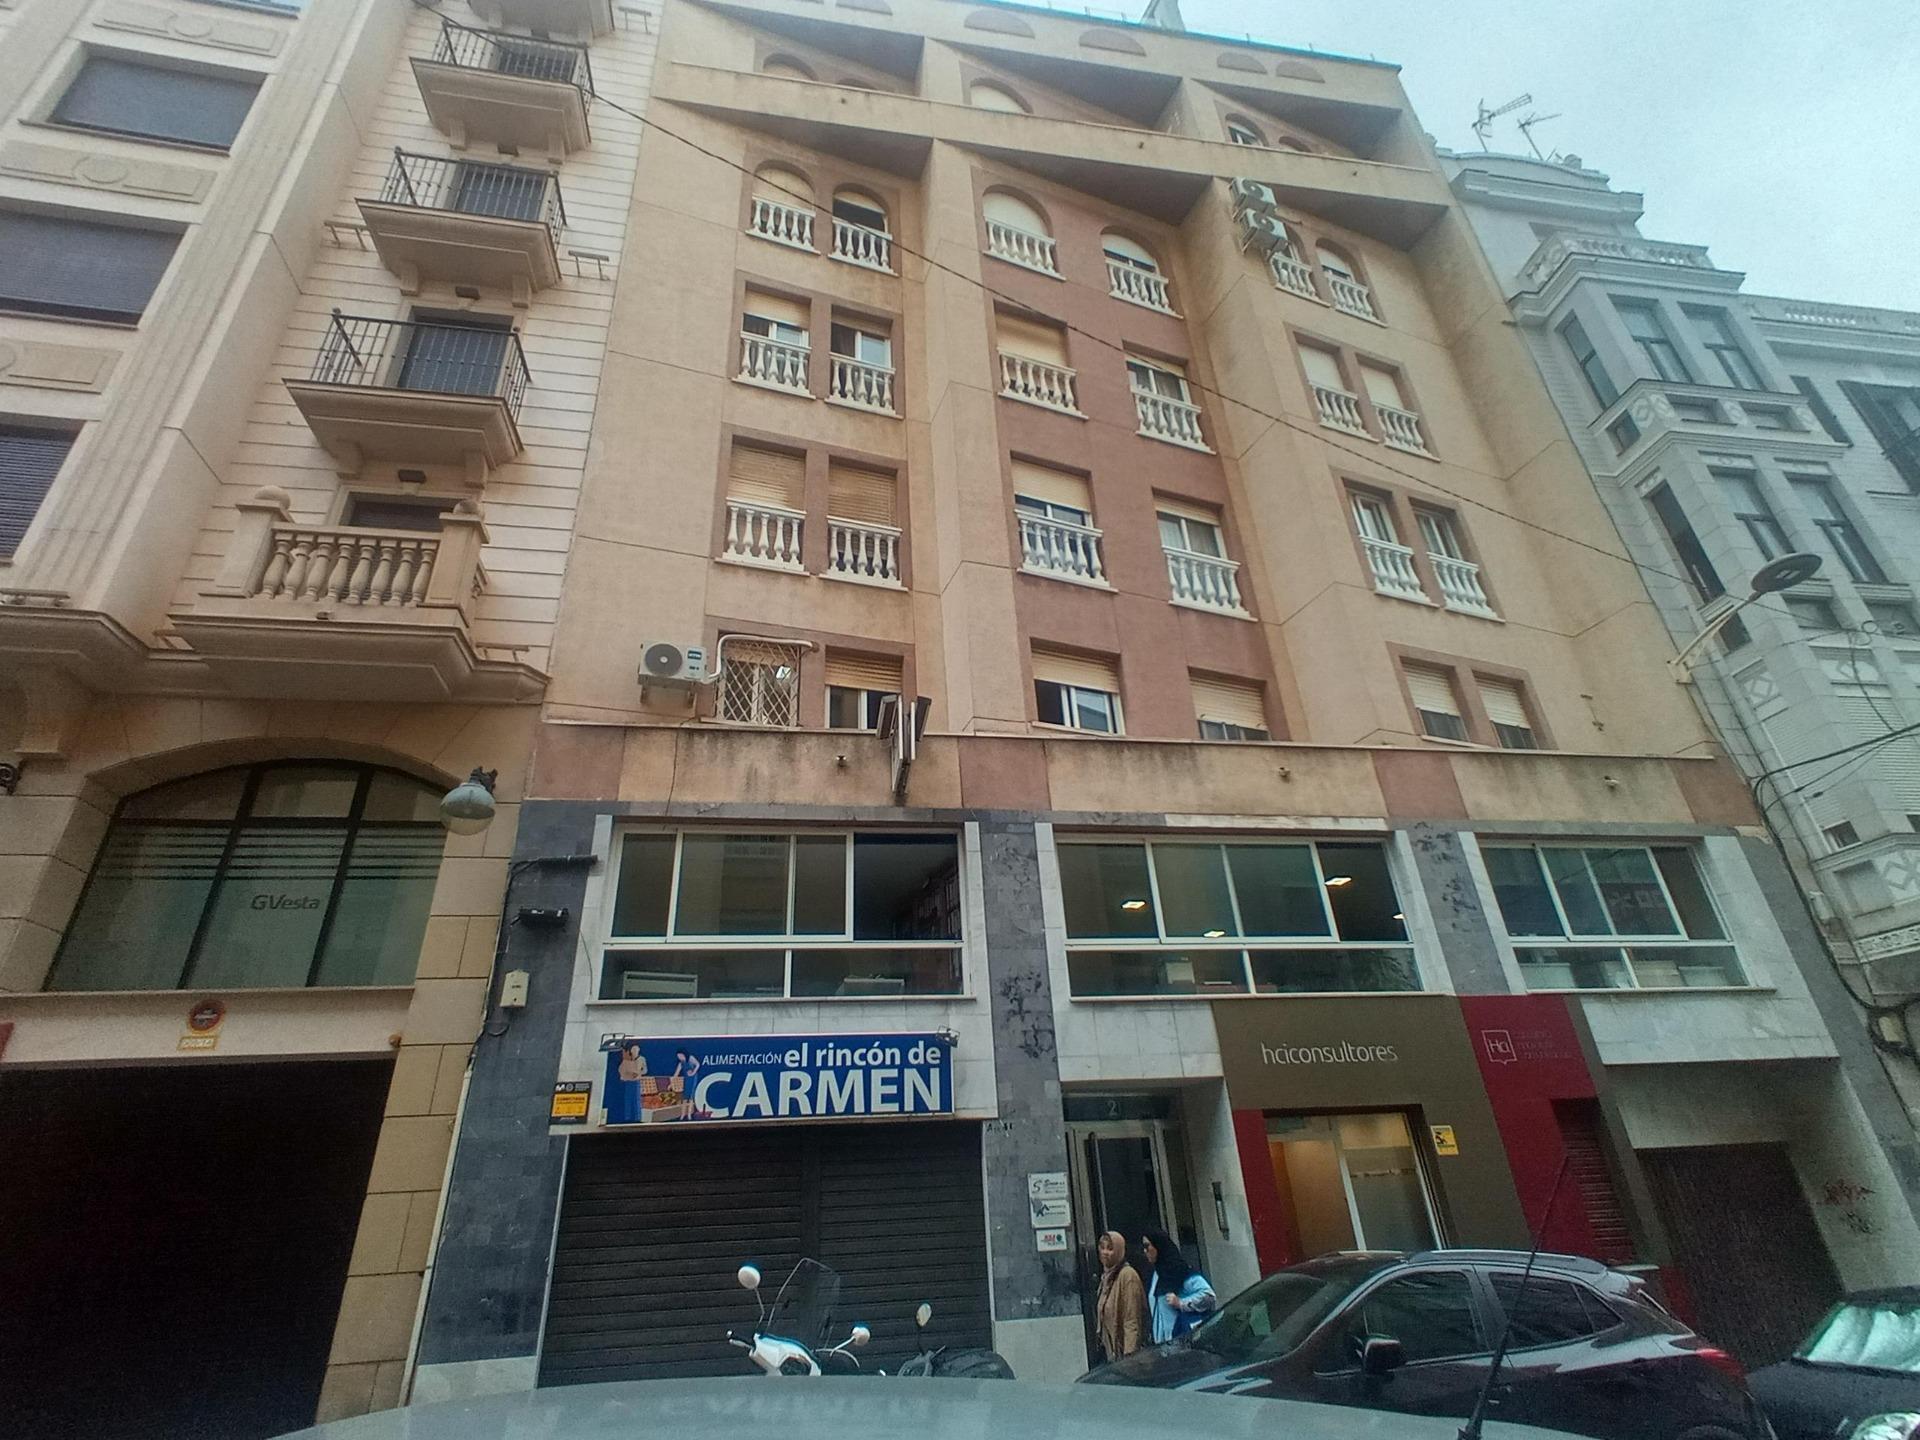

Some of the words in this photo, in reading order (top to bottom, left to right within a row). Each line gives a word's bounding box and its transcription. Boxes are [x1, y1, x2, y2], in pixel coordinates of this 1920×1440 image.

[251, 894, 320, 910] GVesta
[702, 1051, 782, 1066] ALIMENTACIÓN
[784, 1042, 808, 1067] el
[815, 1041, 901, 1067] rincón
[907, 1040, 941, 1065] de
[1261, 1040, 1398, 1065] hciconsultores
[694, 1067, 941, 1119] CARMEN
[1107, 1100, 1119, 1118] 2
